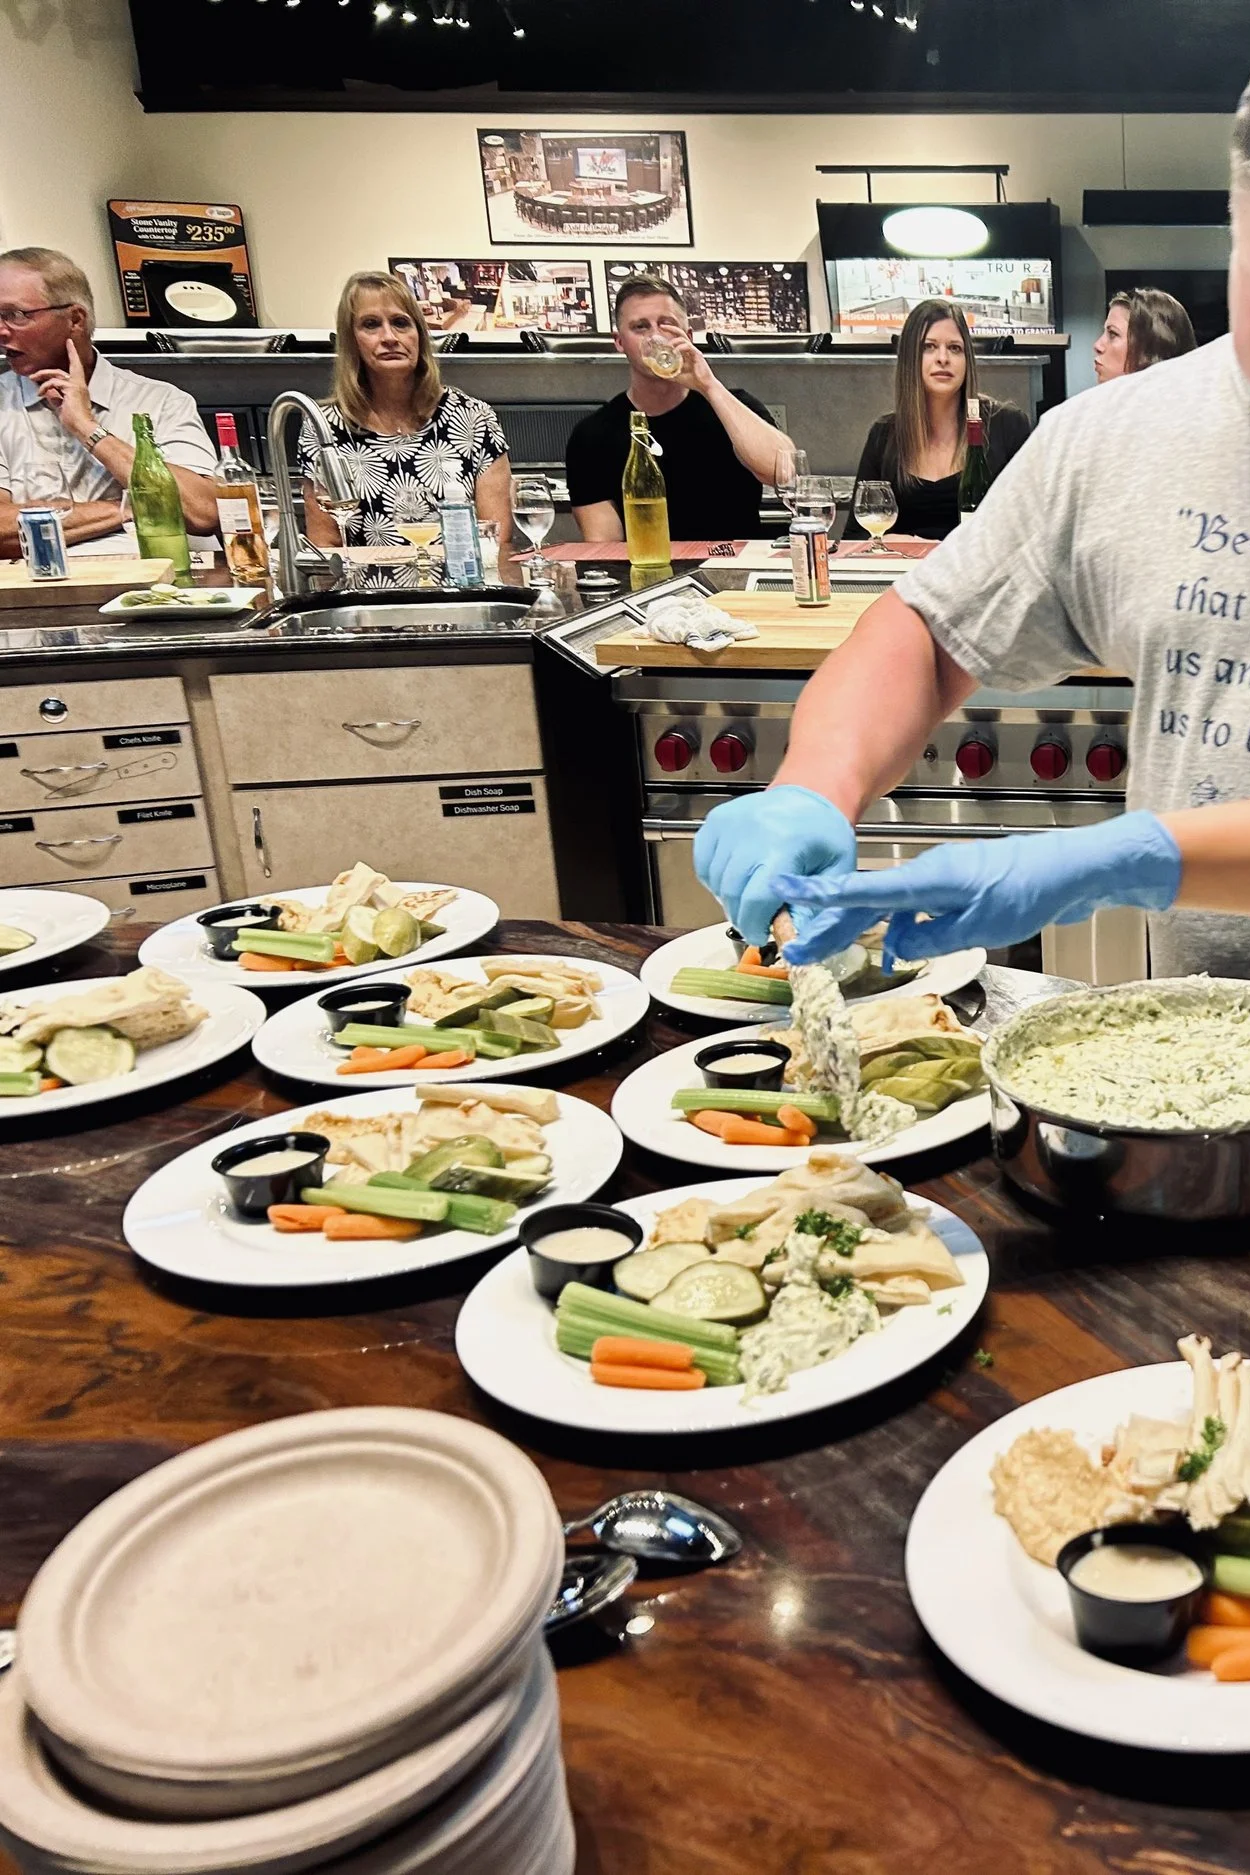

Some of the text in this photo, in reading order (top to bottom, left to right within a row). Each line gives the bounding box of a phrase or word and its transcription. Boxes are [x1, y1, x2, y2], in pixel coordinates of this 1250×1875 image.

[130, 218, 178, 228] Stone Vanity
[133, 226, 178, 235] Countertop
[988, 263, 1014, 273] TRU
[1173, 576, 1247, 621] that
[1165, 647, 1201, 677] us
[1159, 708, 1188, 738] us
[1202, 716, 1232, 747] to
[464, 787, 503, 796] Dish Soap
[153, 809, 173, 817] Knife
[454, 804, 520, 814] Dishwasher Soap
